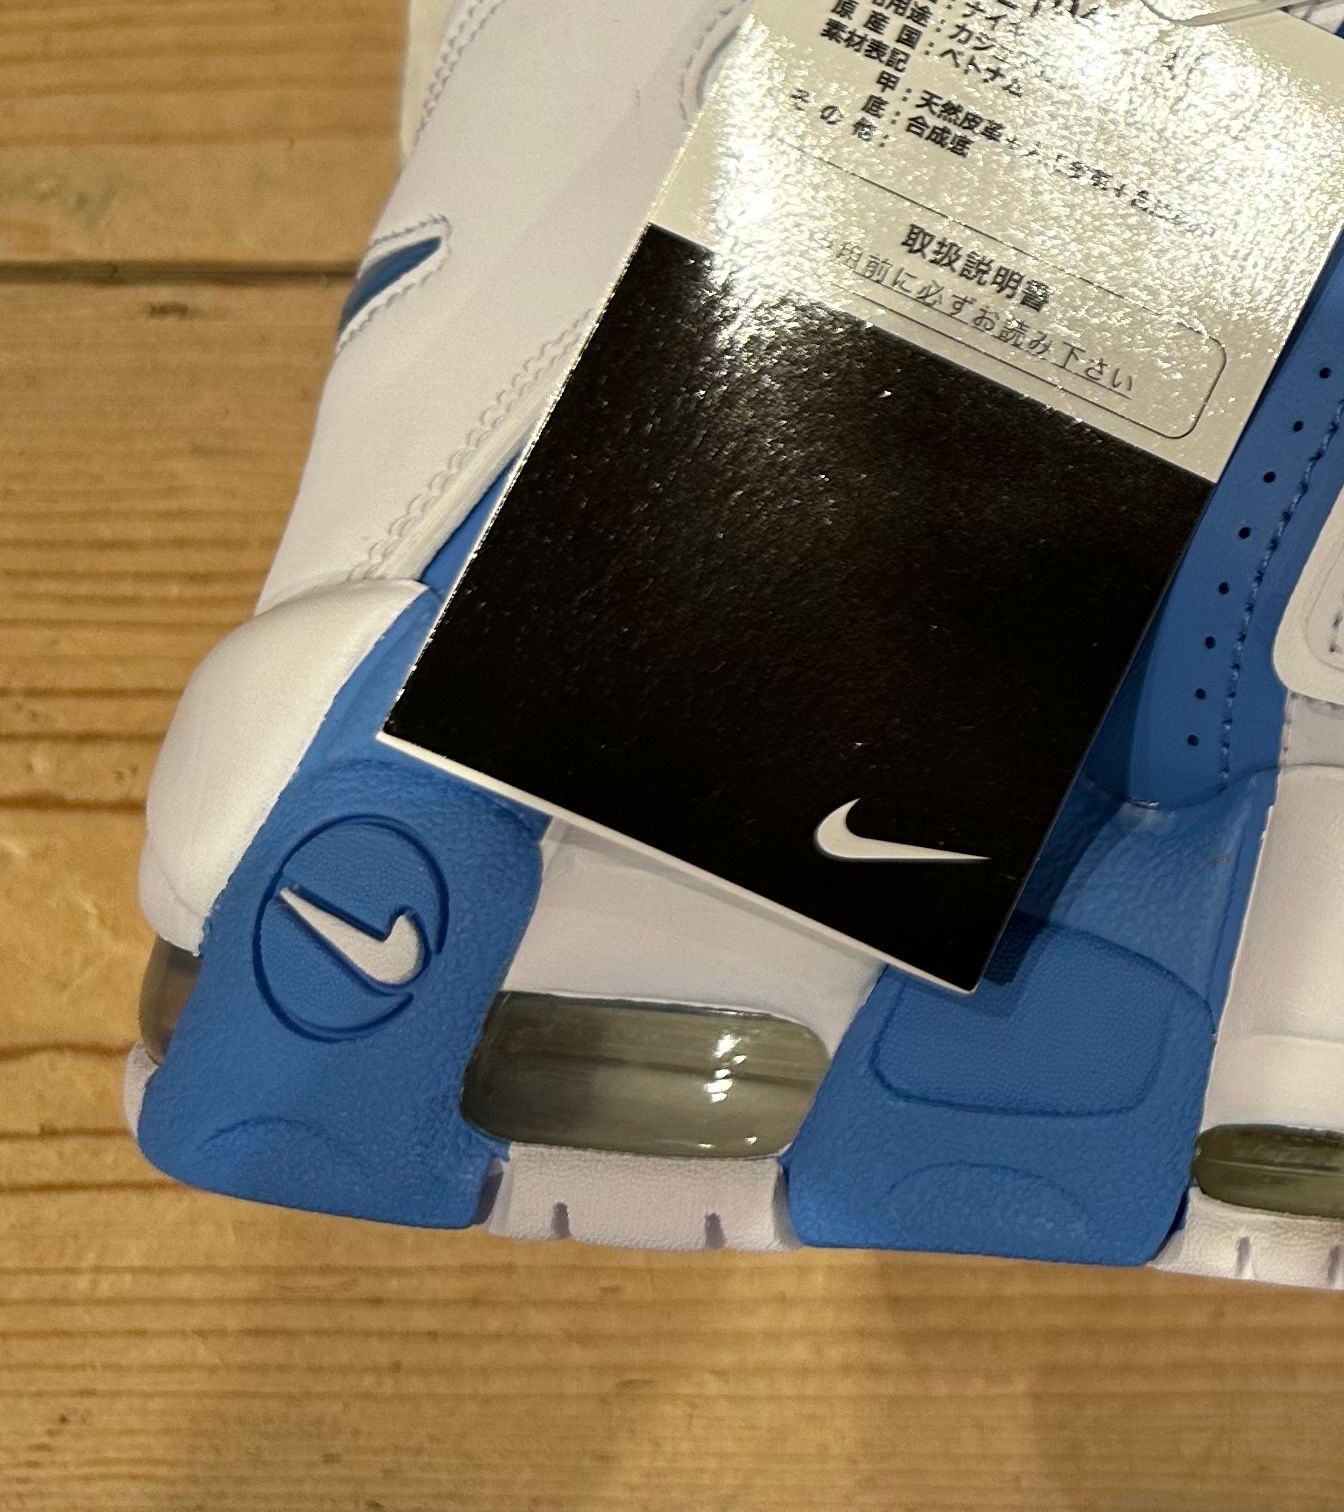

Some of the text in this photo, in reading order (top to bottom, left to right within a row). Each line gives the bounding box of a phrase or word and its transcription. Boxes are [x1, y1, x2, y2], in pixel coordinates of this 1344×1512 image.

[820, 17, 911, 73] 素材表記
[904, 111, 975, 158] 合成底
[898, 221, 1054, 314] 取扱説明書
[785, 215, 1138, 398] 用前に必ずお読み下さい
